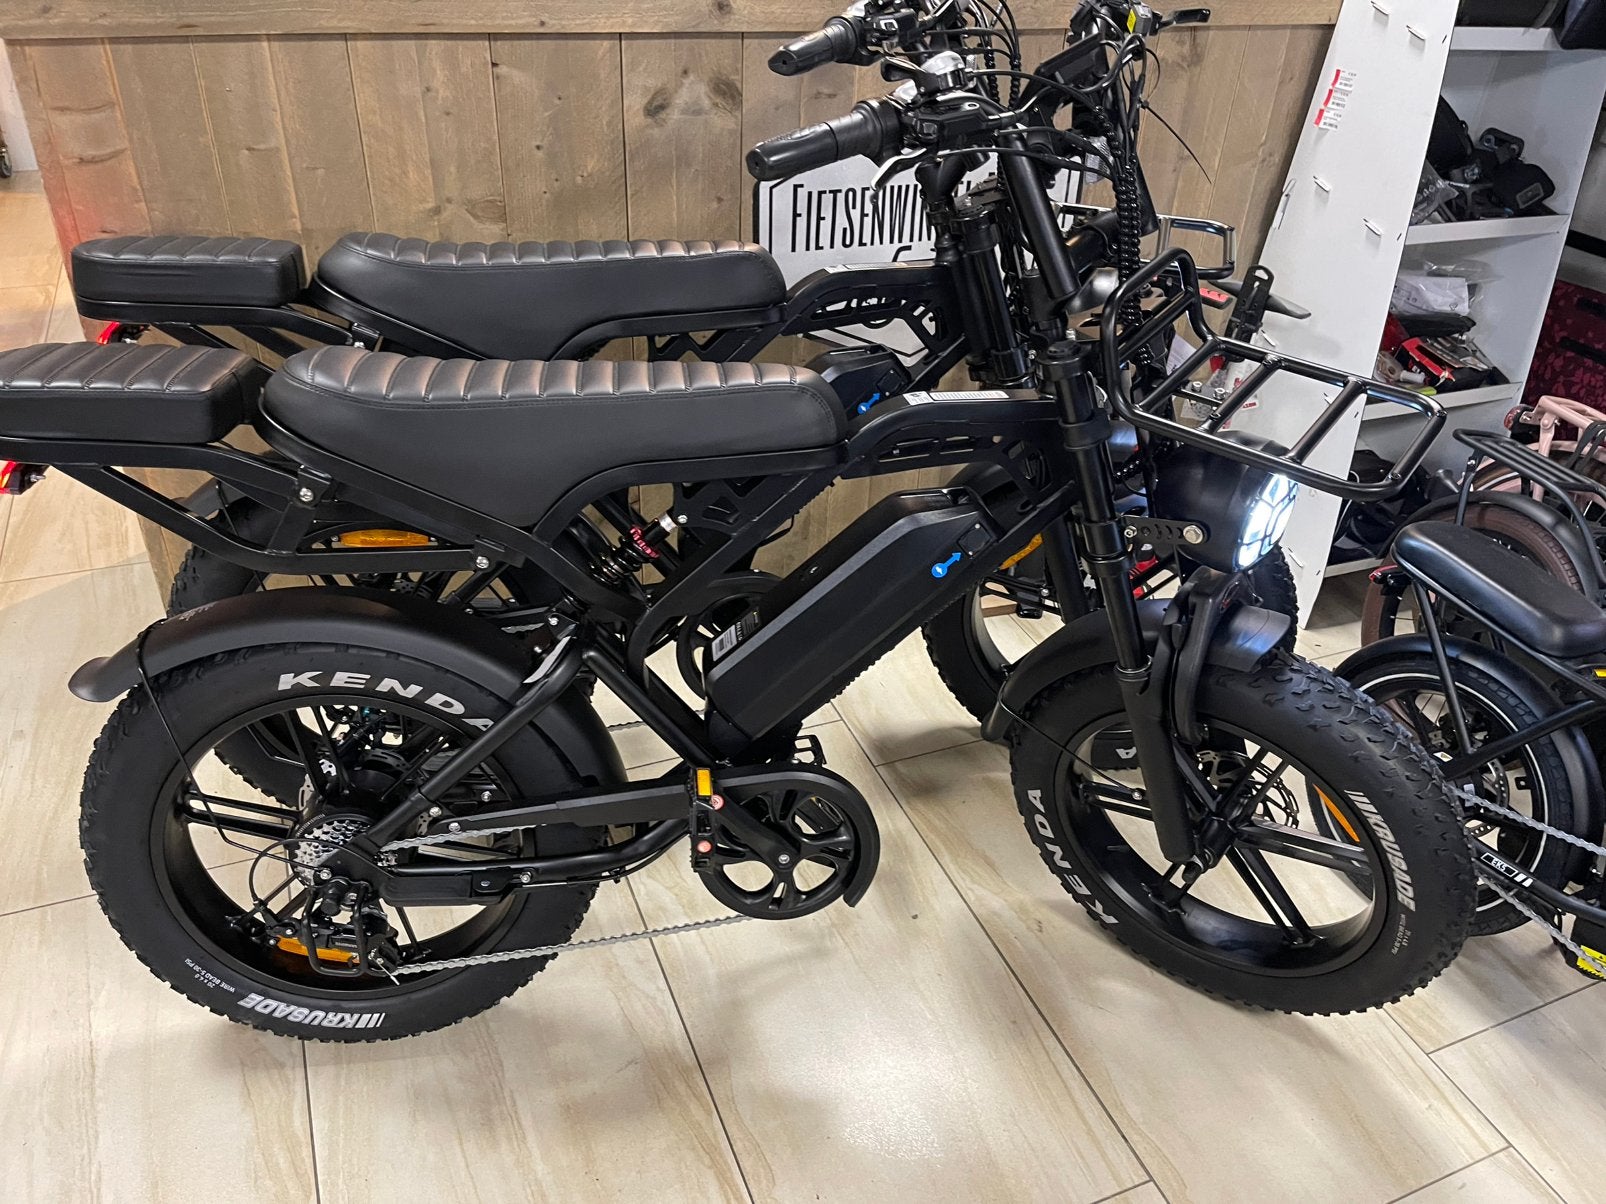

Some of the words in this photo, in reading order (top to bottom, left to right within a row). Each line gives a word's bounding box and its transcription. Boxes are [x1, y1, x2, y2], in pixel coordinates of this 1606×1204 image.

[790, 180, 972, 253] FIETSENWIN
[277, 671, 495, 732] KENDA
[1026, 789, 1120, 925] KENDA
[1360, 809, 1416, 912] KRUSADE
[237, 992, 360, 1029] KRUSADE
